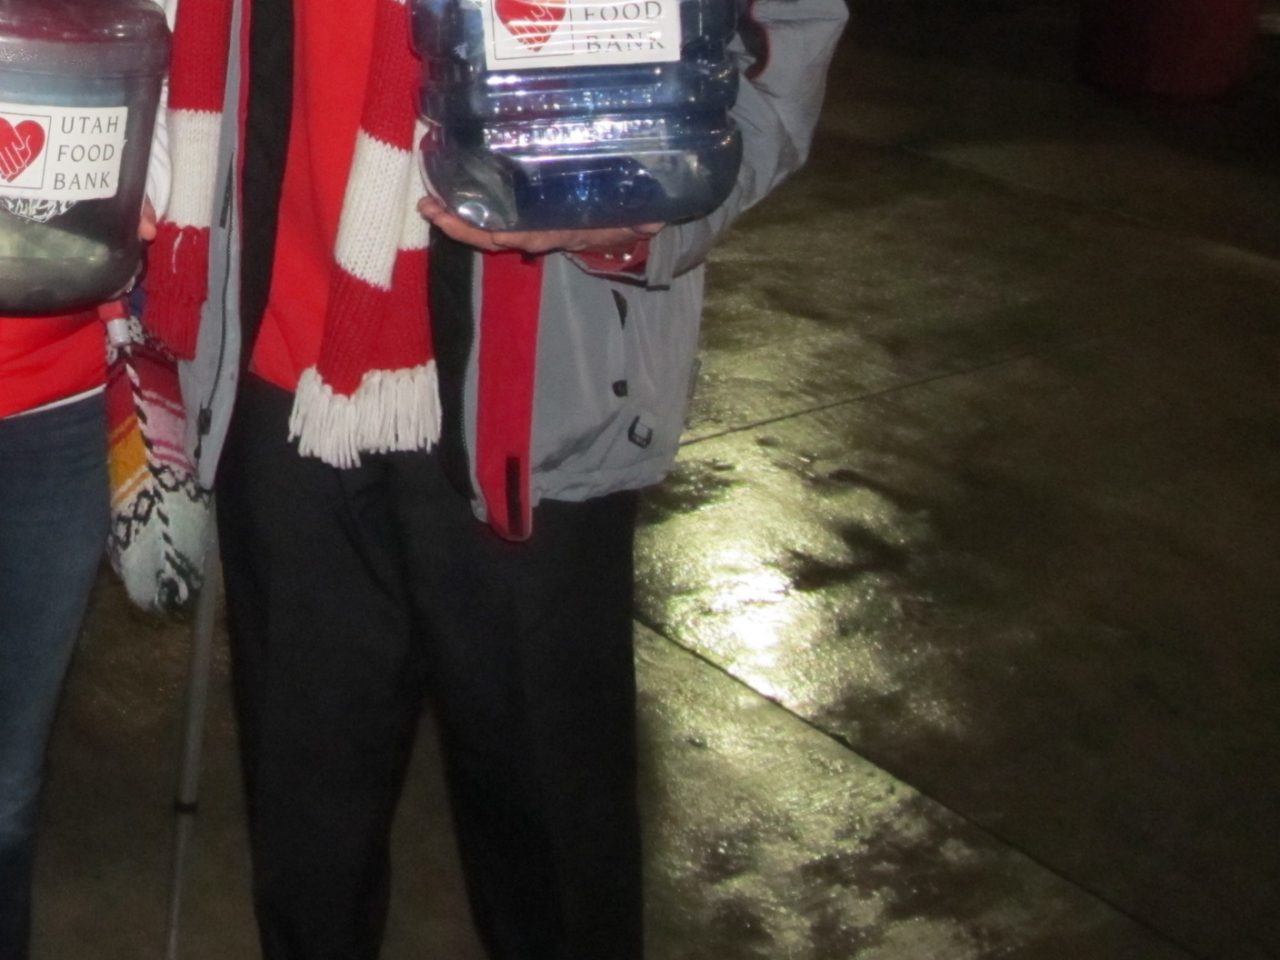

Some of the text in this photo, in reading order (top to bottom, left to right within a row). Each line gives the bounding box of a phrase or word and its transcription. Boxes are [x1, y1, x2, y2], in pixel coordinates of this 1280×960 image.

[584, 1, 662, 21] FOOD
[586, 31, 665, 54] BANK
[61, 115, 119, 134] UTAH
[57, 144, 115, 162] FOOD
[53, 171, 110, 190] BANK
